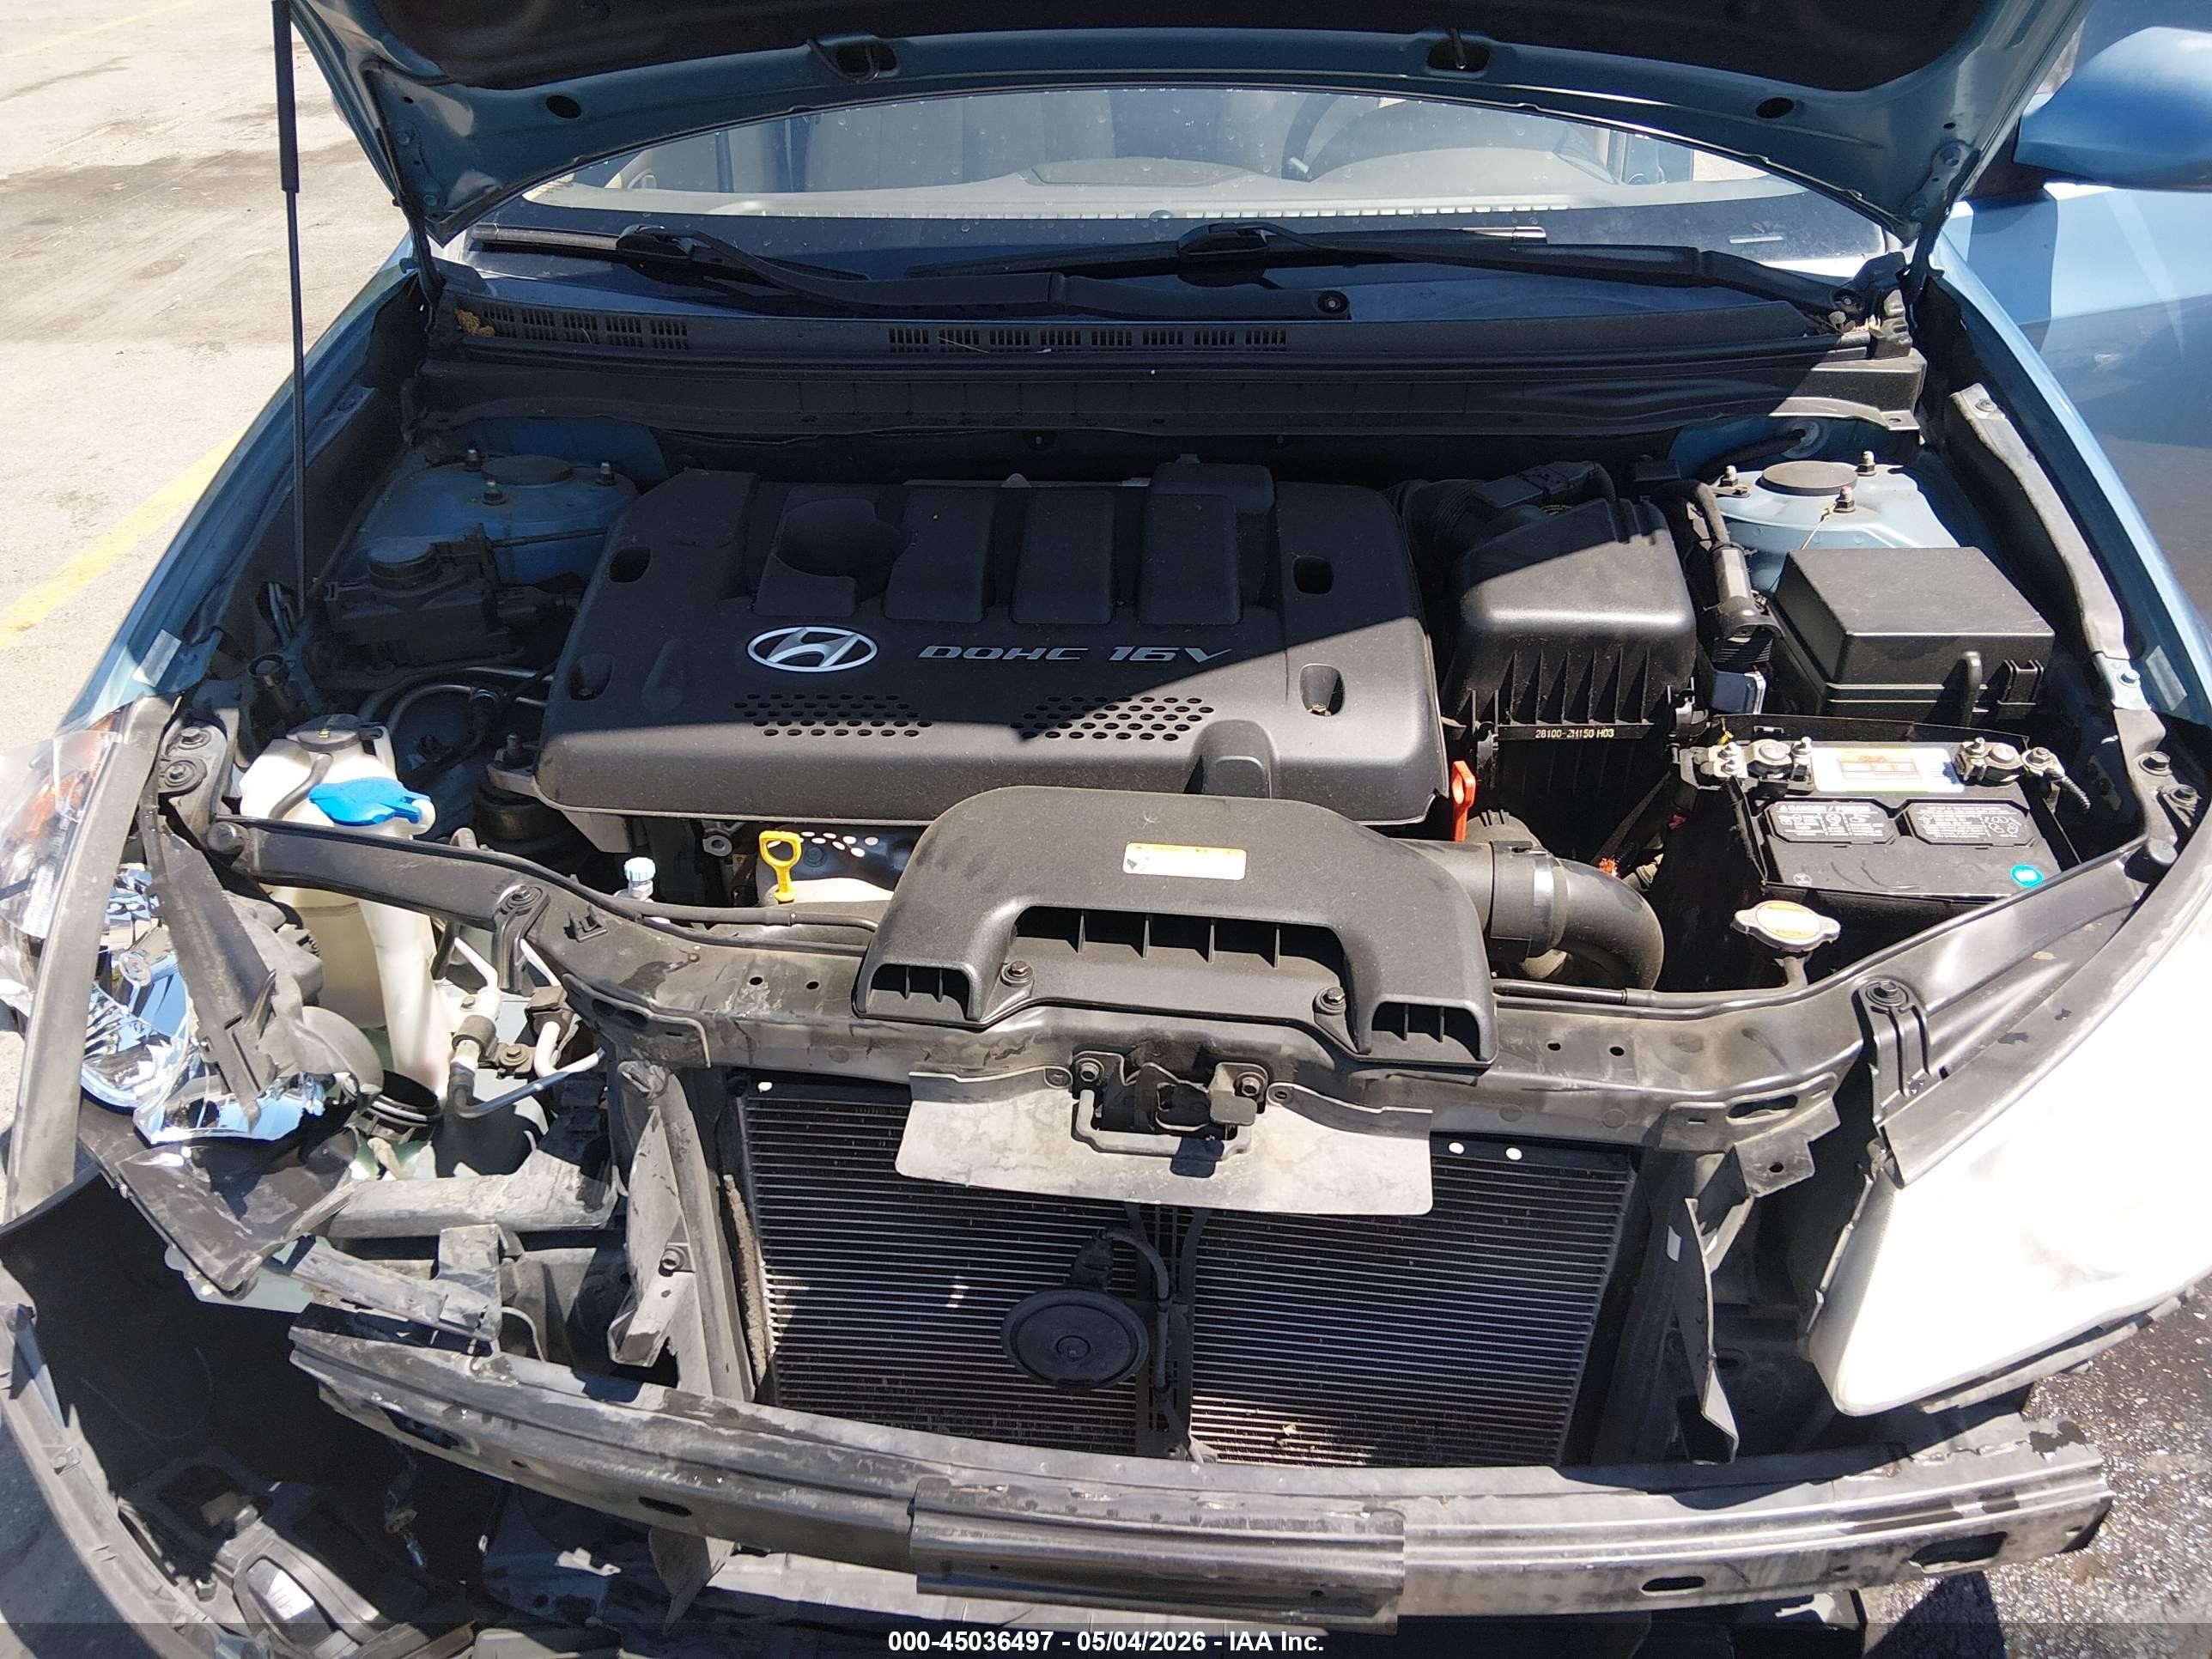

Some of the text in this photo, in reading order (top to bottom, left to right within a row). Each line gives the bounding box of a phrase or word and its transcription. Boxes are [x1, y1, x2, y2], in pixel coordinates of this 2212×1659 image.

[917, 644, 1232, 665] DOHC 16V
[1535, 728, 1614, 738] 28100-2H150 H03
